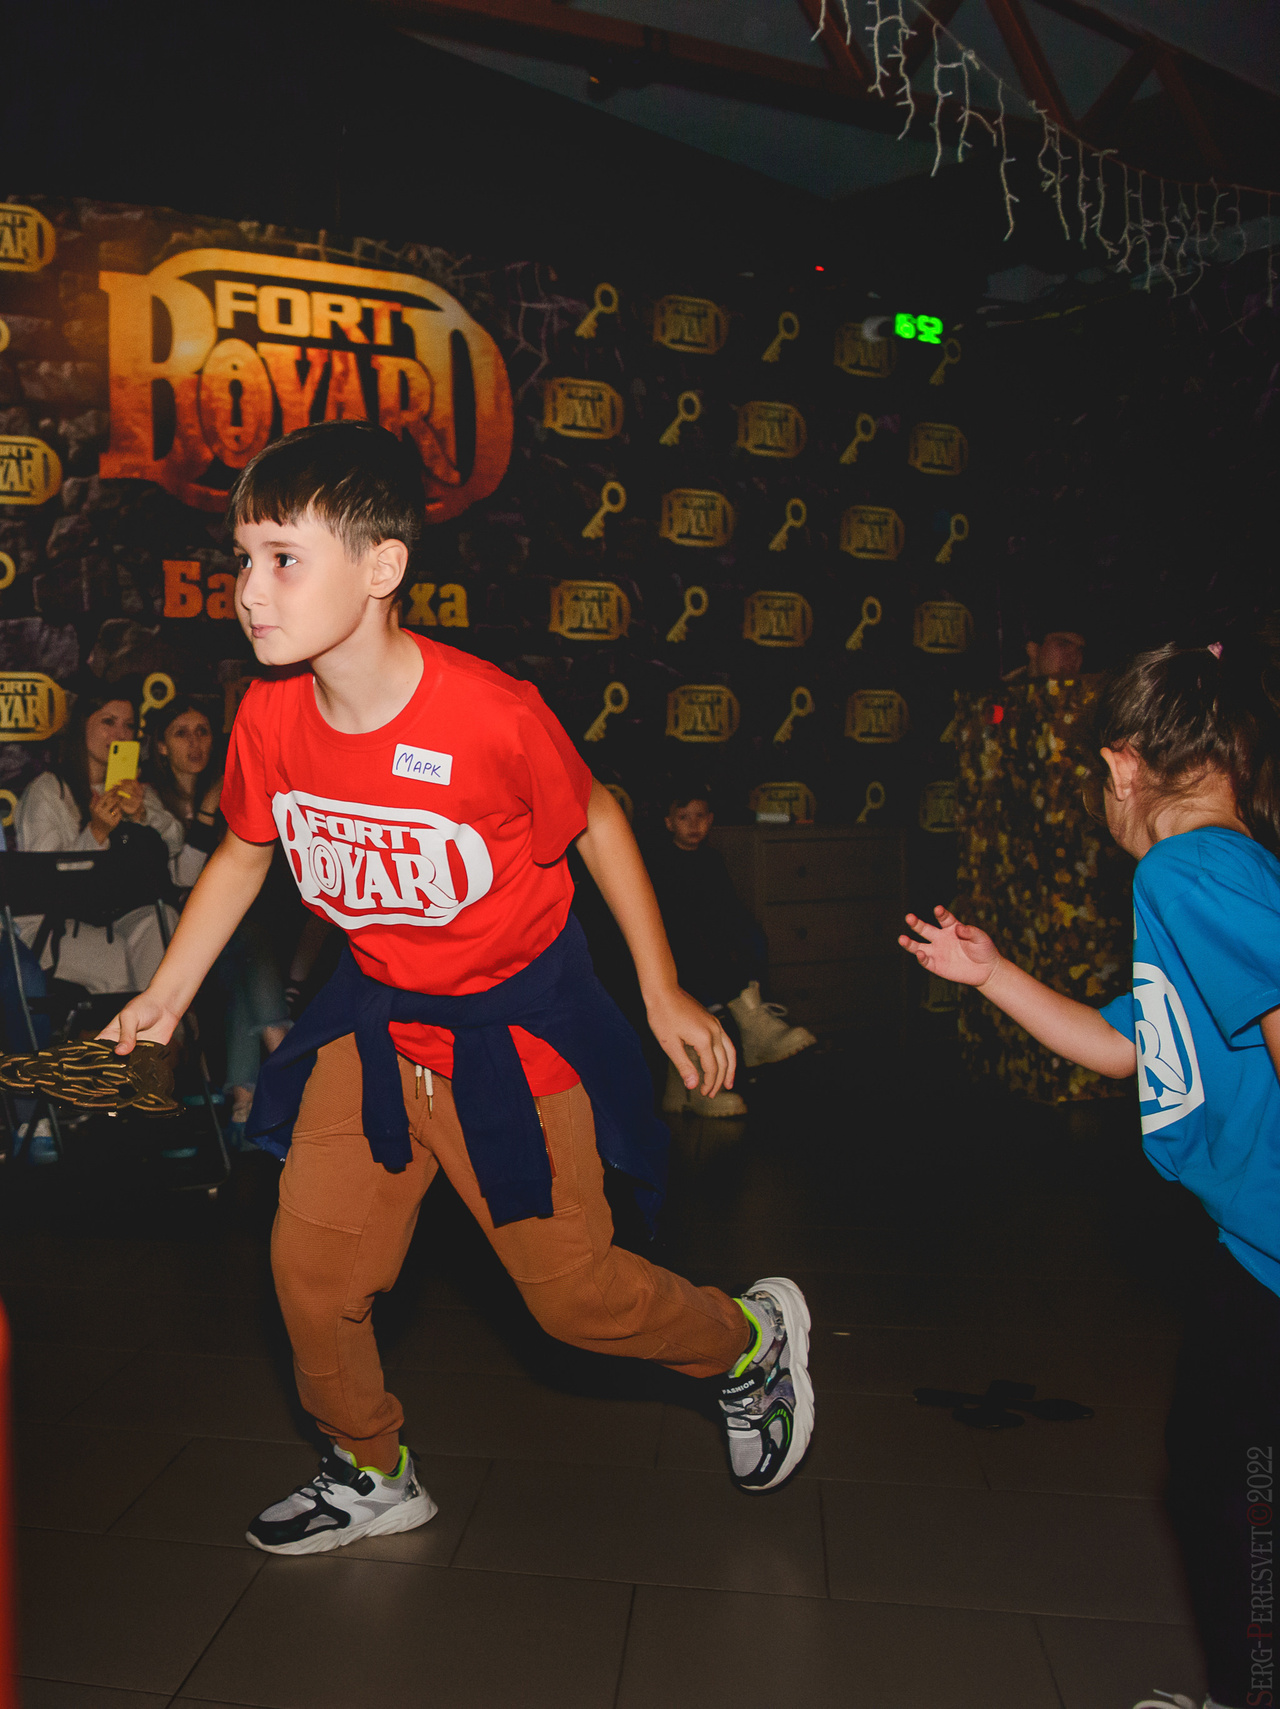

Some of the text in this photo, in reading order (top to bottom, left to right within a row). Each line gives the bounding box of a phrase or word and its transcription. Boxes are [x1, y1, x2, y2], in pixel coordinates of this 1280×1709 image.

[214, 280, 403, 345] FORT
[99, 248, 514, 524] BOYARD
[163, 560, 469, 628] Баха
[272, 790, 494, 930] BOYARD
[306, 810, 411, 849] FORT
